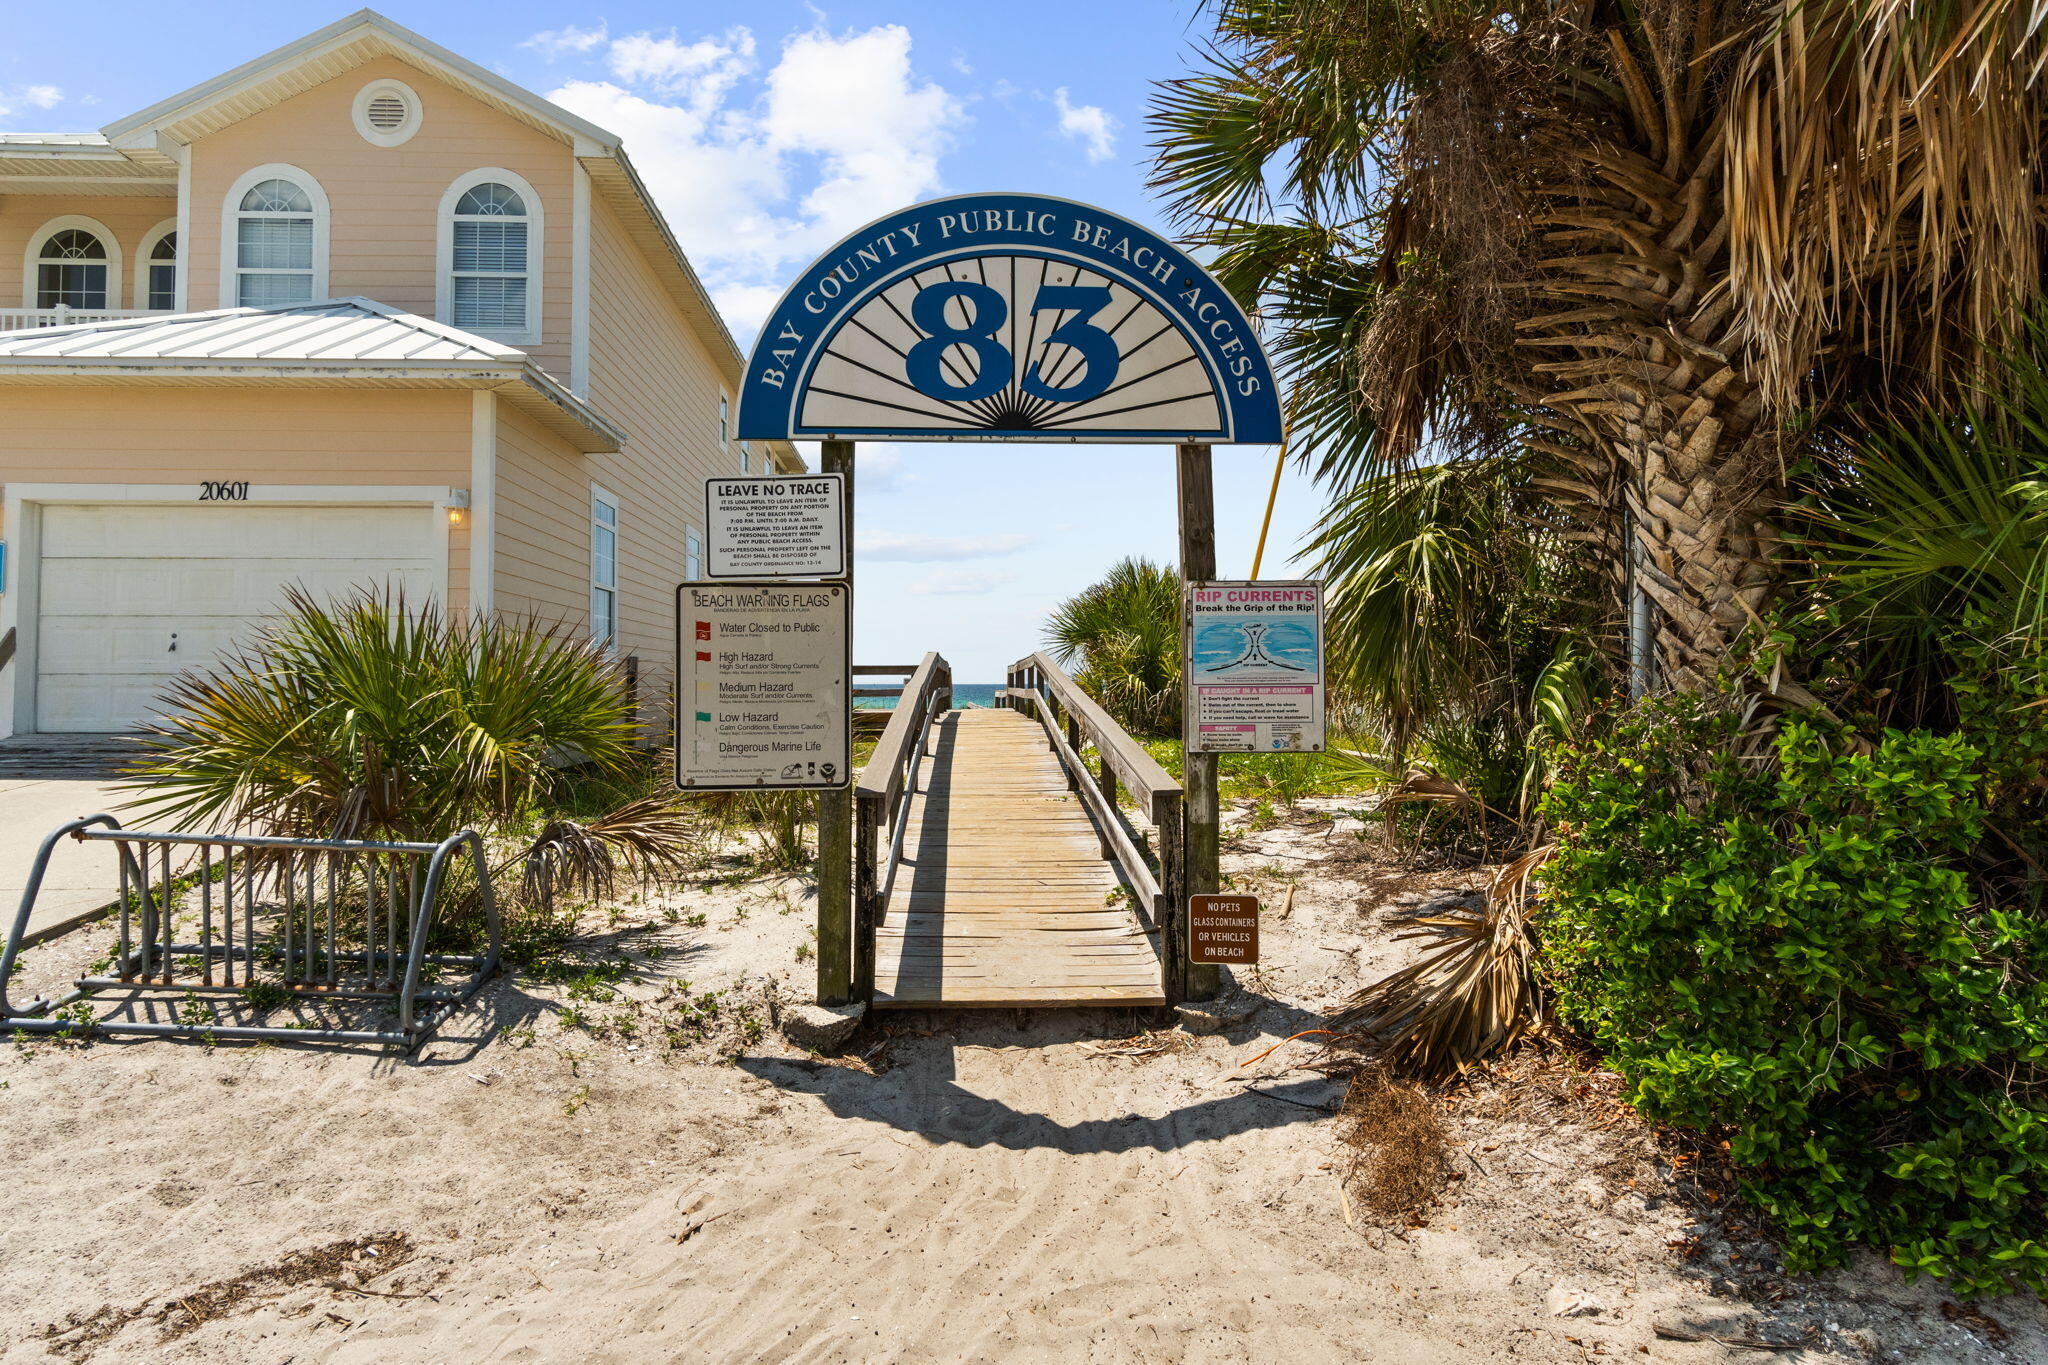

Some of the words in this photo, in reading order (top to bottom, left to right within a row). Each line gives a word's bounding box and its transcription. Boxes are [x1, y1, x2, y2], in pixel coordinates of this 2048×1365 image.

[762, 321, 805, 390] BAY
[804, 223, 922, 315] COUNTY
[938, 208, 1057, 239] PUBLIC
[1072, 220, 1177, 284] BEACH
[1179, 288, 1261, 398] ACCESS
[905, 281, 1120, 402] 83
[199, 481, 249, 501] 20601
[718, 485, 758, 496] LEAVE
[764, 485, 784, 495] NO
[789, 483, 829, 494] TRACE
[694, 595, 732, 607] BEACH
[737, 595, 789, 607] WARNING
[793, 595, 829, 606] FLAGS
[1196, 591, 1222, 602] RIP
[1227, 590, 1315, 602] CURRENTS
[1244, 604, 1263, 613] Grip
[1297, 604, 1314, 612] Rip!
[720, 623, 746, 632] Water
[749, 623, 779, 632] Closed
[783, 623, 791, 632] to
[794, 622, 820, 632] Public
[720, 652, 738, 663] High
[742, 652, 773, 661] Hazard
[720, 683, 756, 691] Medium
[760, 682, 793, 691] Hazard
[720, 713, 739, 722] Low
[743, 712, 778, 722] Hazard
[720, 742, 769, 754] Dangerous
[772, 742, 802, 751] Marine
[806, 741, 821, 750] Life
[1208, 903, 1218, 911] NO
[1221, 903, 1240, 912] PETS
[1194, 918, 1214, 926] GLASS
[1216, 918, 1255, 927] CONTAINERS
[1199, 932, 1209, 940] OR
[1212, 933, 1250, 942] VEHICLES
[1205, 947, 1215, 956] ON
[1218, 948, 1244, 956] BEACH
